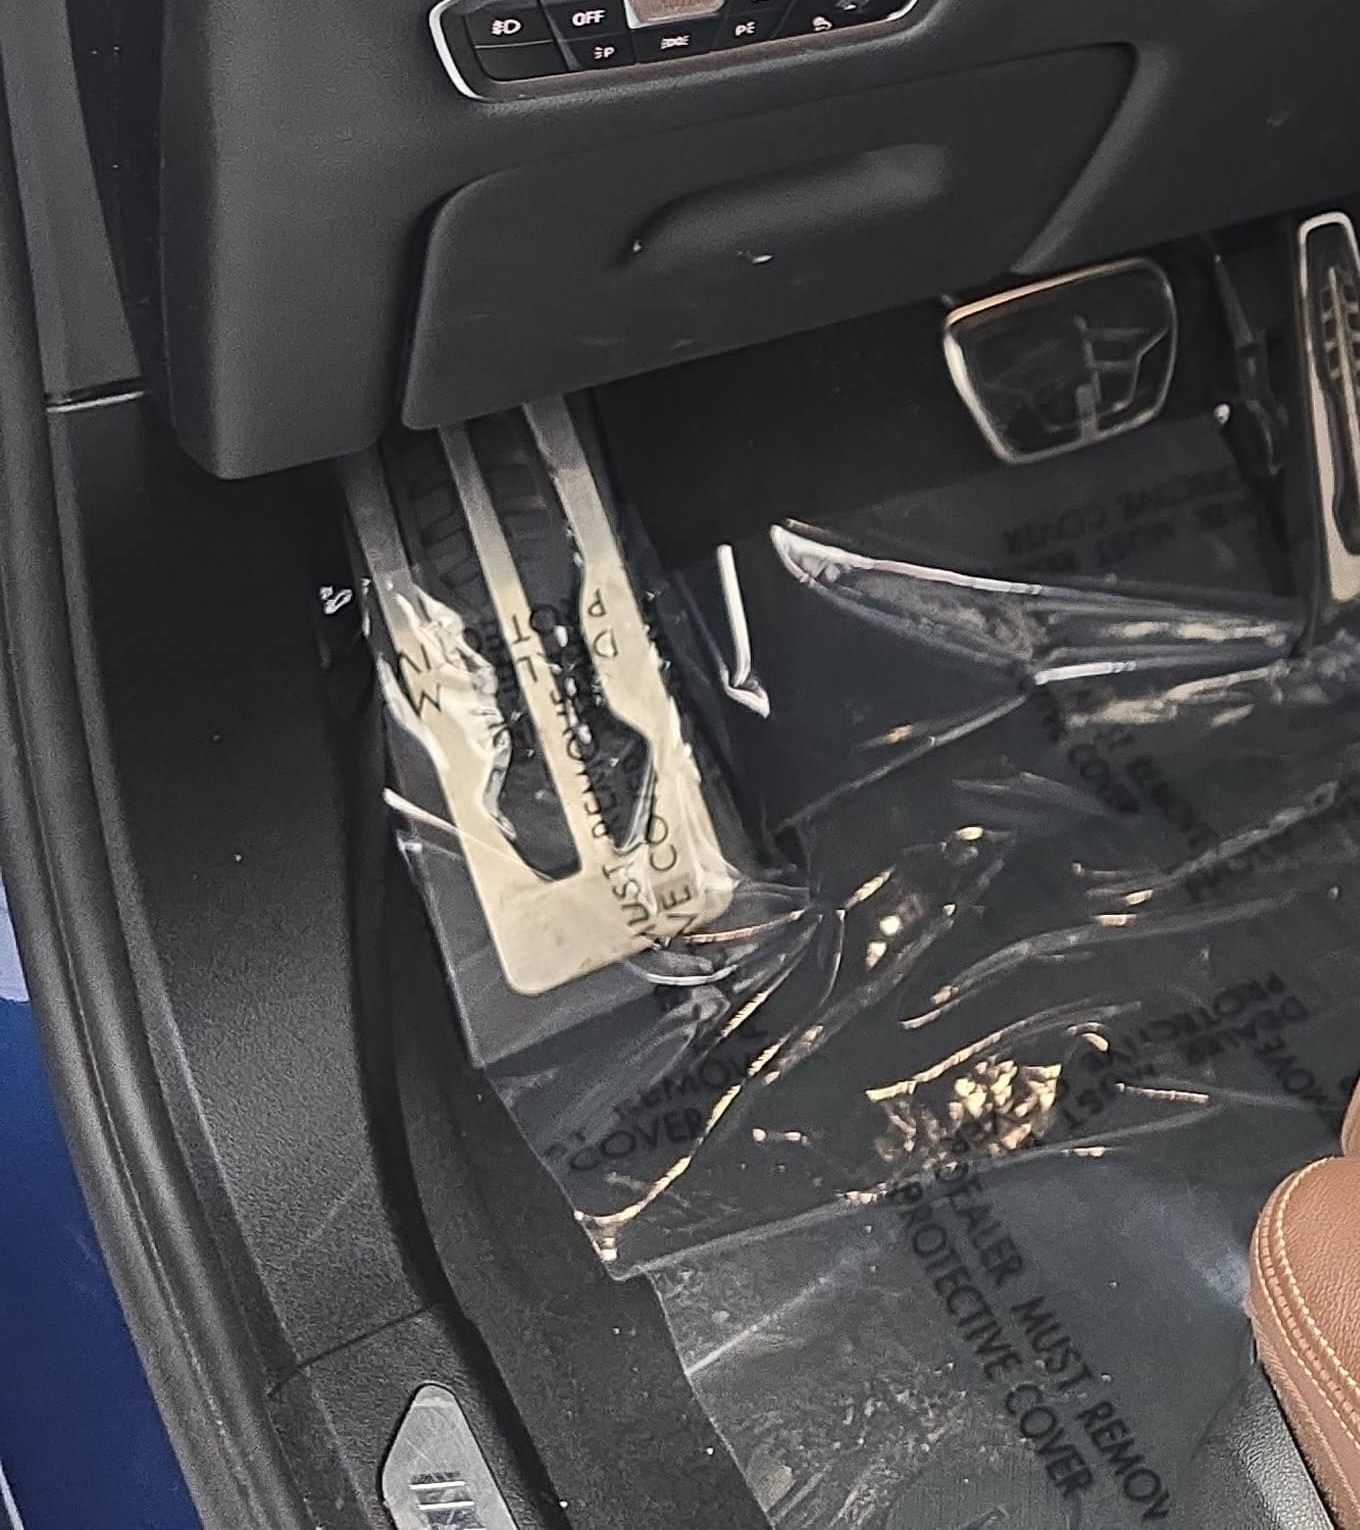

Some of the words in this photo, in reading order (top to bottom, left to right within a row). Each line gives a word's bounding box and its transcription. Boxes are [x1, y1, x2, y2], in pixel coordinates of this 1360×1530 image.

[571, 9, 606, 27] OFF
[890, 1181, 1022, 1382] PROTECTIVE
[933, 1162, 1025, 1288] DEALER
[1010, 1295, 1093, 1392] MUST
[1004, 1384, 1095, 1499] COVER
